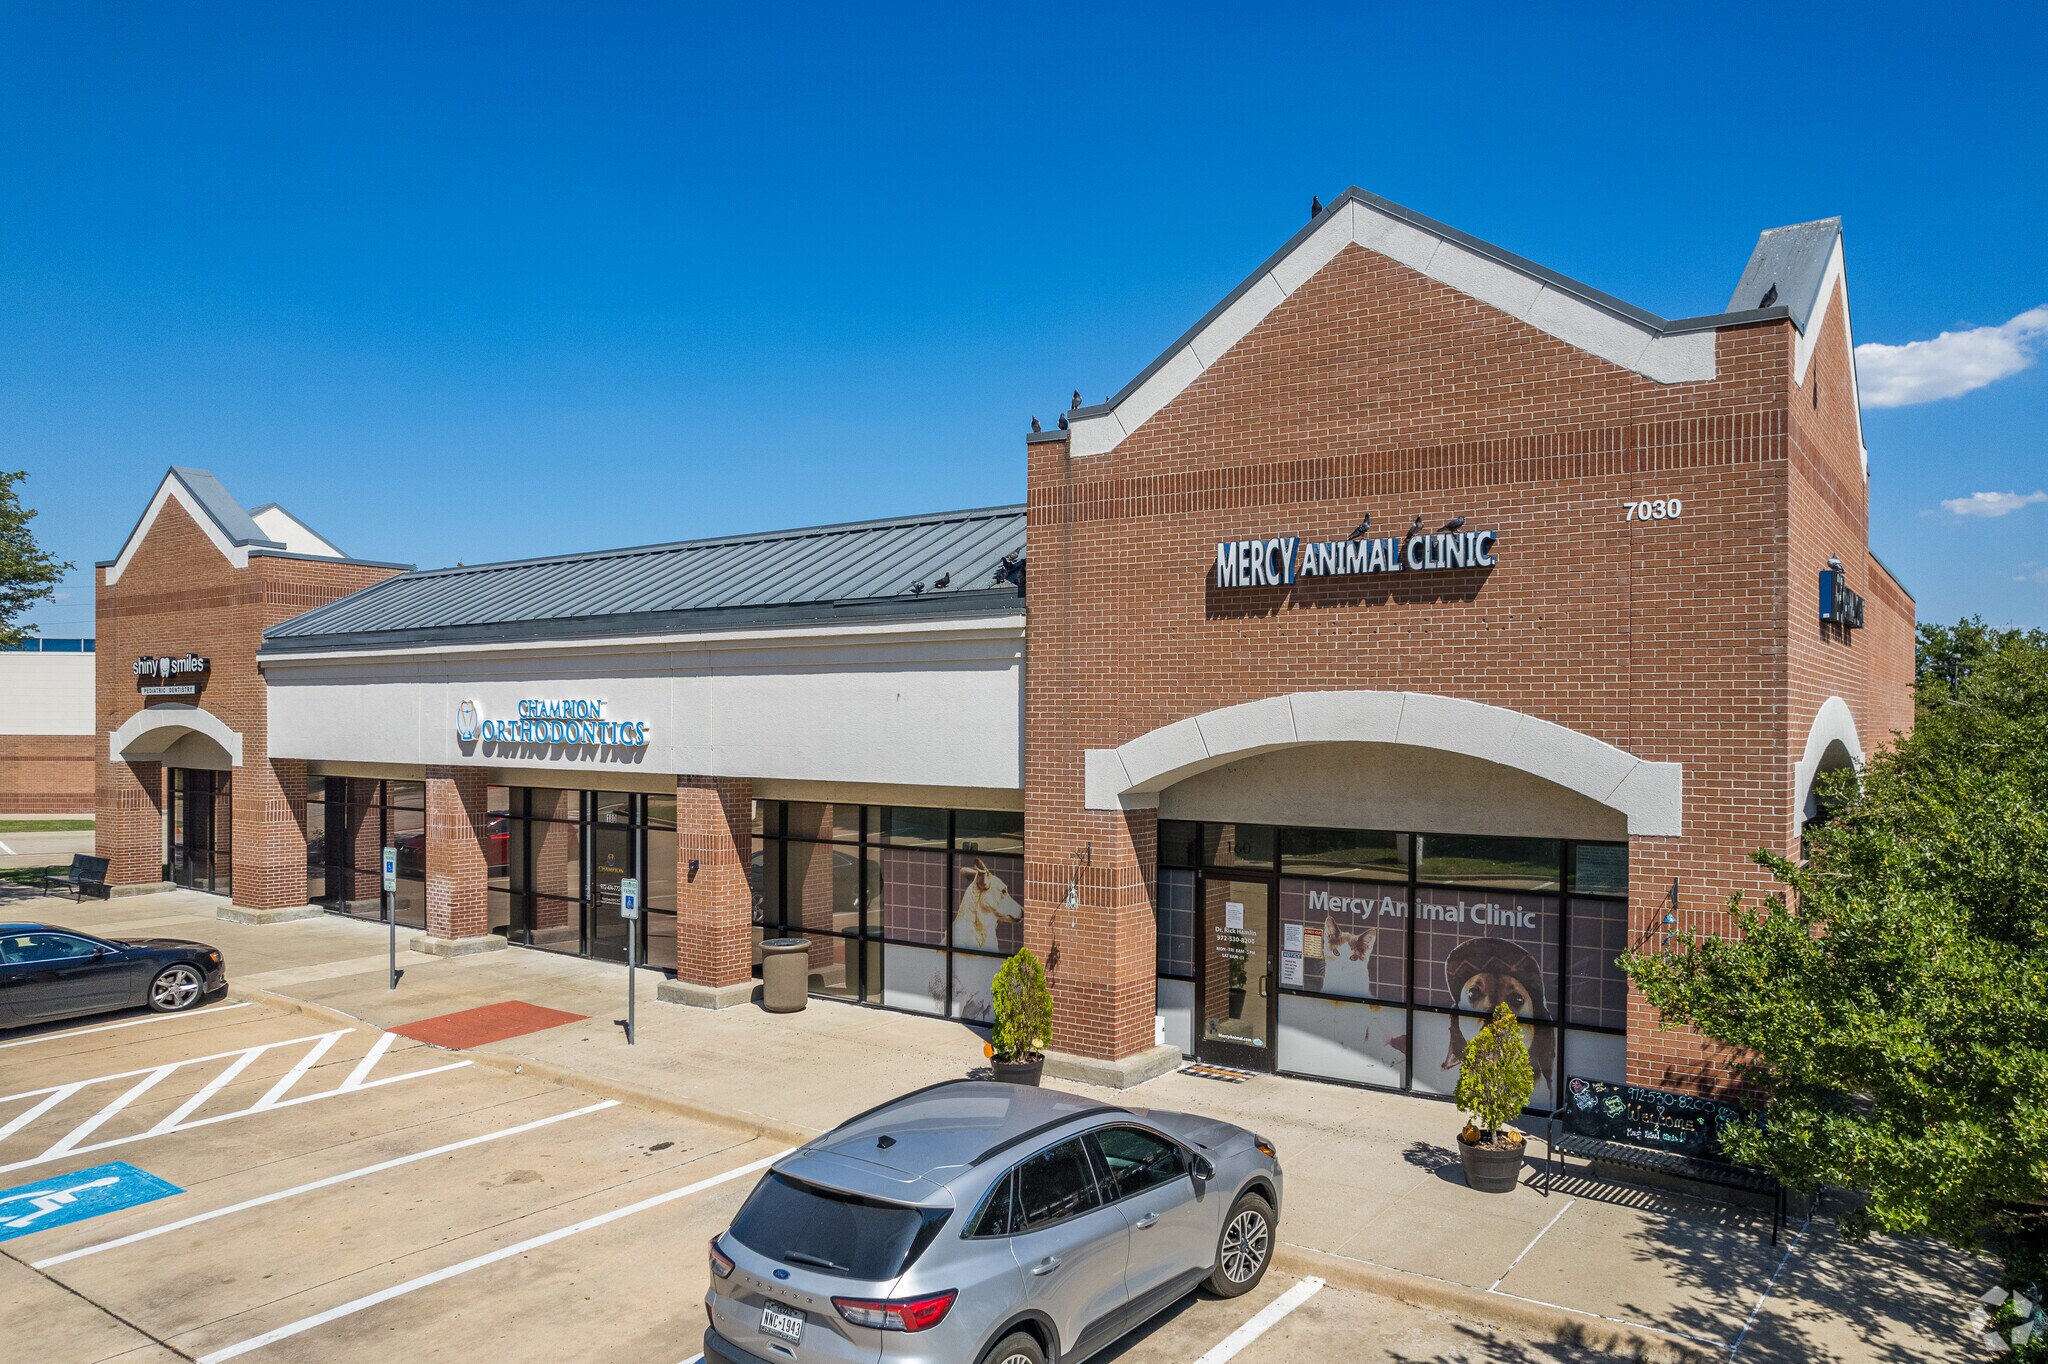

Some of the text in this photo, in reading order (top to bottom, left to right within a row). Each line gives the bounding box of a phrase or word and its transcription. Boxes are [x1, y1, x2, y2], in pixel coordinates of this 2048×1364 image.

[1624, 499, 1682, 521] 7030
[1217, 531, 1495, 588] MERCY ANIMAL CLINIC
[133, 653, 204, 677] shiny smiles
[518, 700, 601, 719] CHAMPION
[482, 720, 645, 746] ORTHODONTICS
[1309, 891, 1536, 929] Mercy Animal Clinic
[1216, 935, 1256, 944] 972-530-8200
[1627, 1087, 1716, 1113] 972-530-8200
[1627, 1103, 1696, 1132] WELCOME
